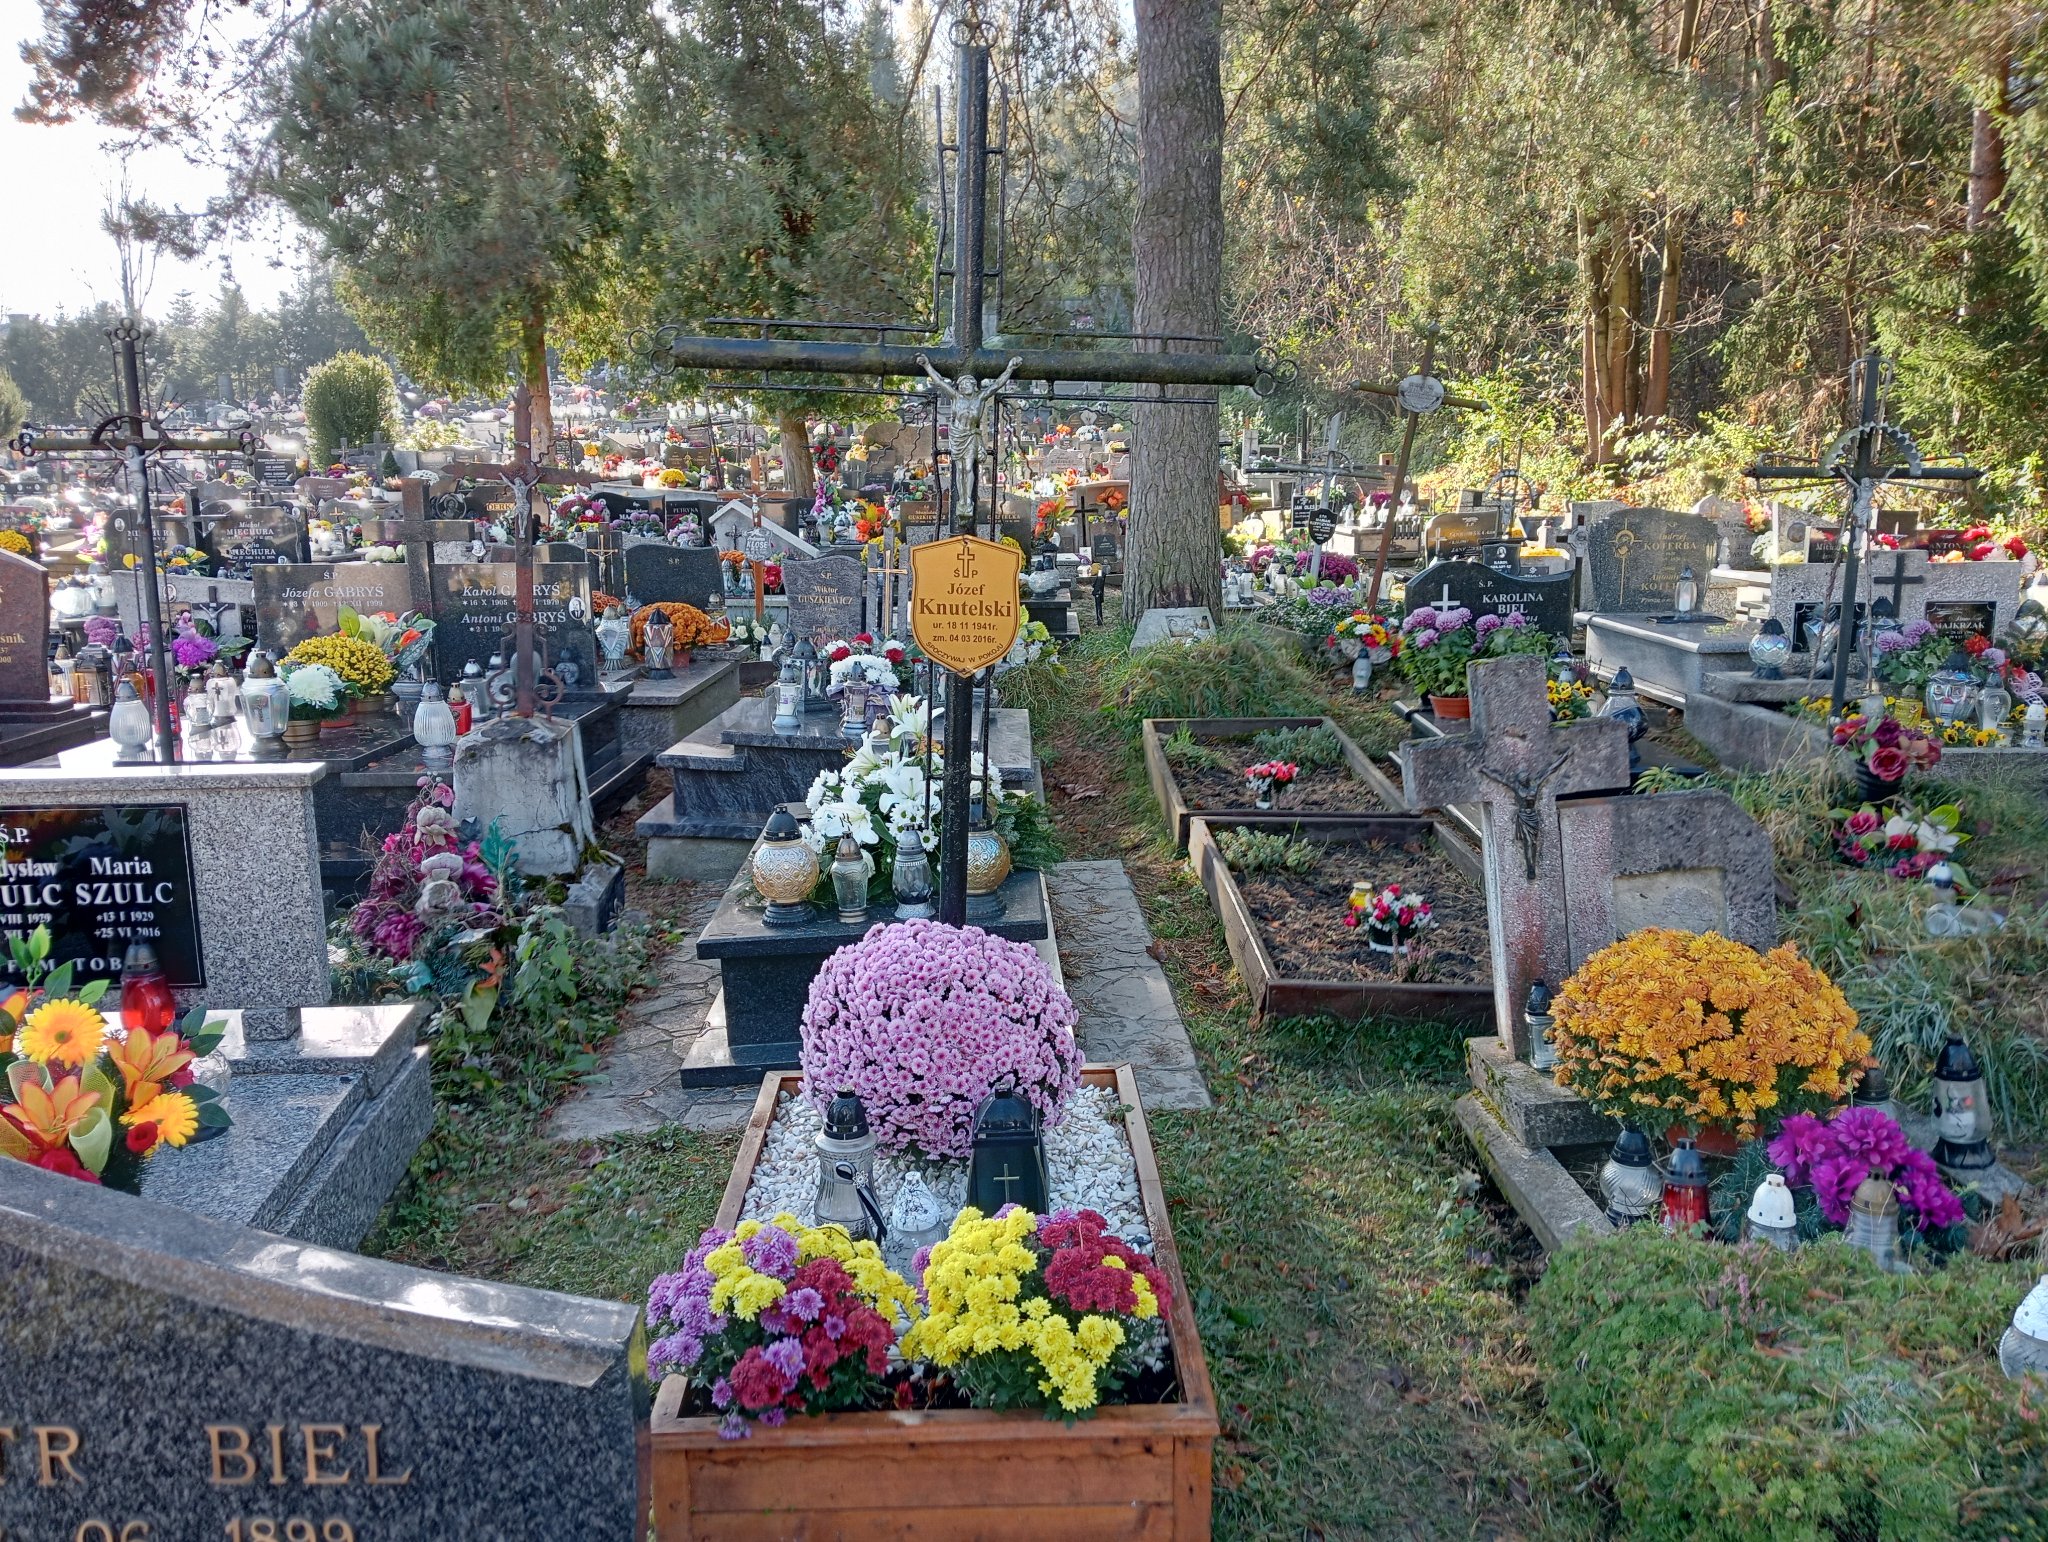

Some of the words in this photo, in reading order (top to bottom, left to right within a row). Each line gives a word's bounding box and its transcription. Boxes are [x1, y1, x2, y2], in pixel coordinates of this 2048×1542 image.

[282, 588, 320, 598] Józefa
[324, 583, 384, 598] GABRYŚ
[462, 585, 497, 597] Karol
[501, 582, 561, 597] GRYŚ
[947, 583, 986, 596] Józef
[1482, 592, 1544, 603] KAROLINA
[918, 598, 1013, 617] Knutelski
[1498, 603, 1528, 614] BIEL
[460, 612, 503, 623] Antoni
[959, 622, 969, 630] 11
[972, 622, 998, 631] 1941r.
[949, 634, 959, 642] 04
[973, 635, 998, 643] 2016r.
[925, 641, 966, 663] SPOCZYWAJ
[978, 643, 1004, 662] POKOJU
[90, 856, 153, 876] Maria
[75, 882, 174, 906] SZULC
[130, 911, 155, 922] 1929
[205, 1423, 413, 1485] BIEL
